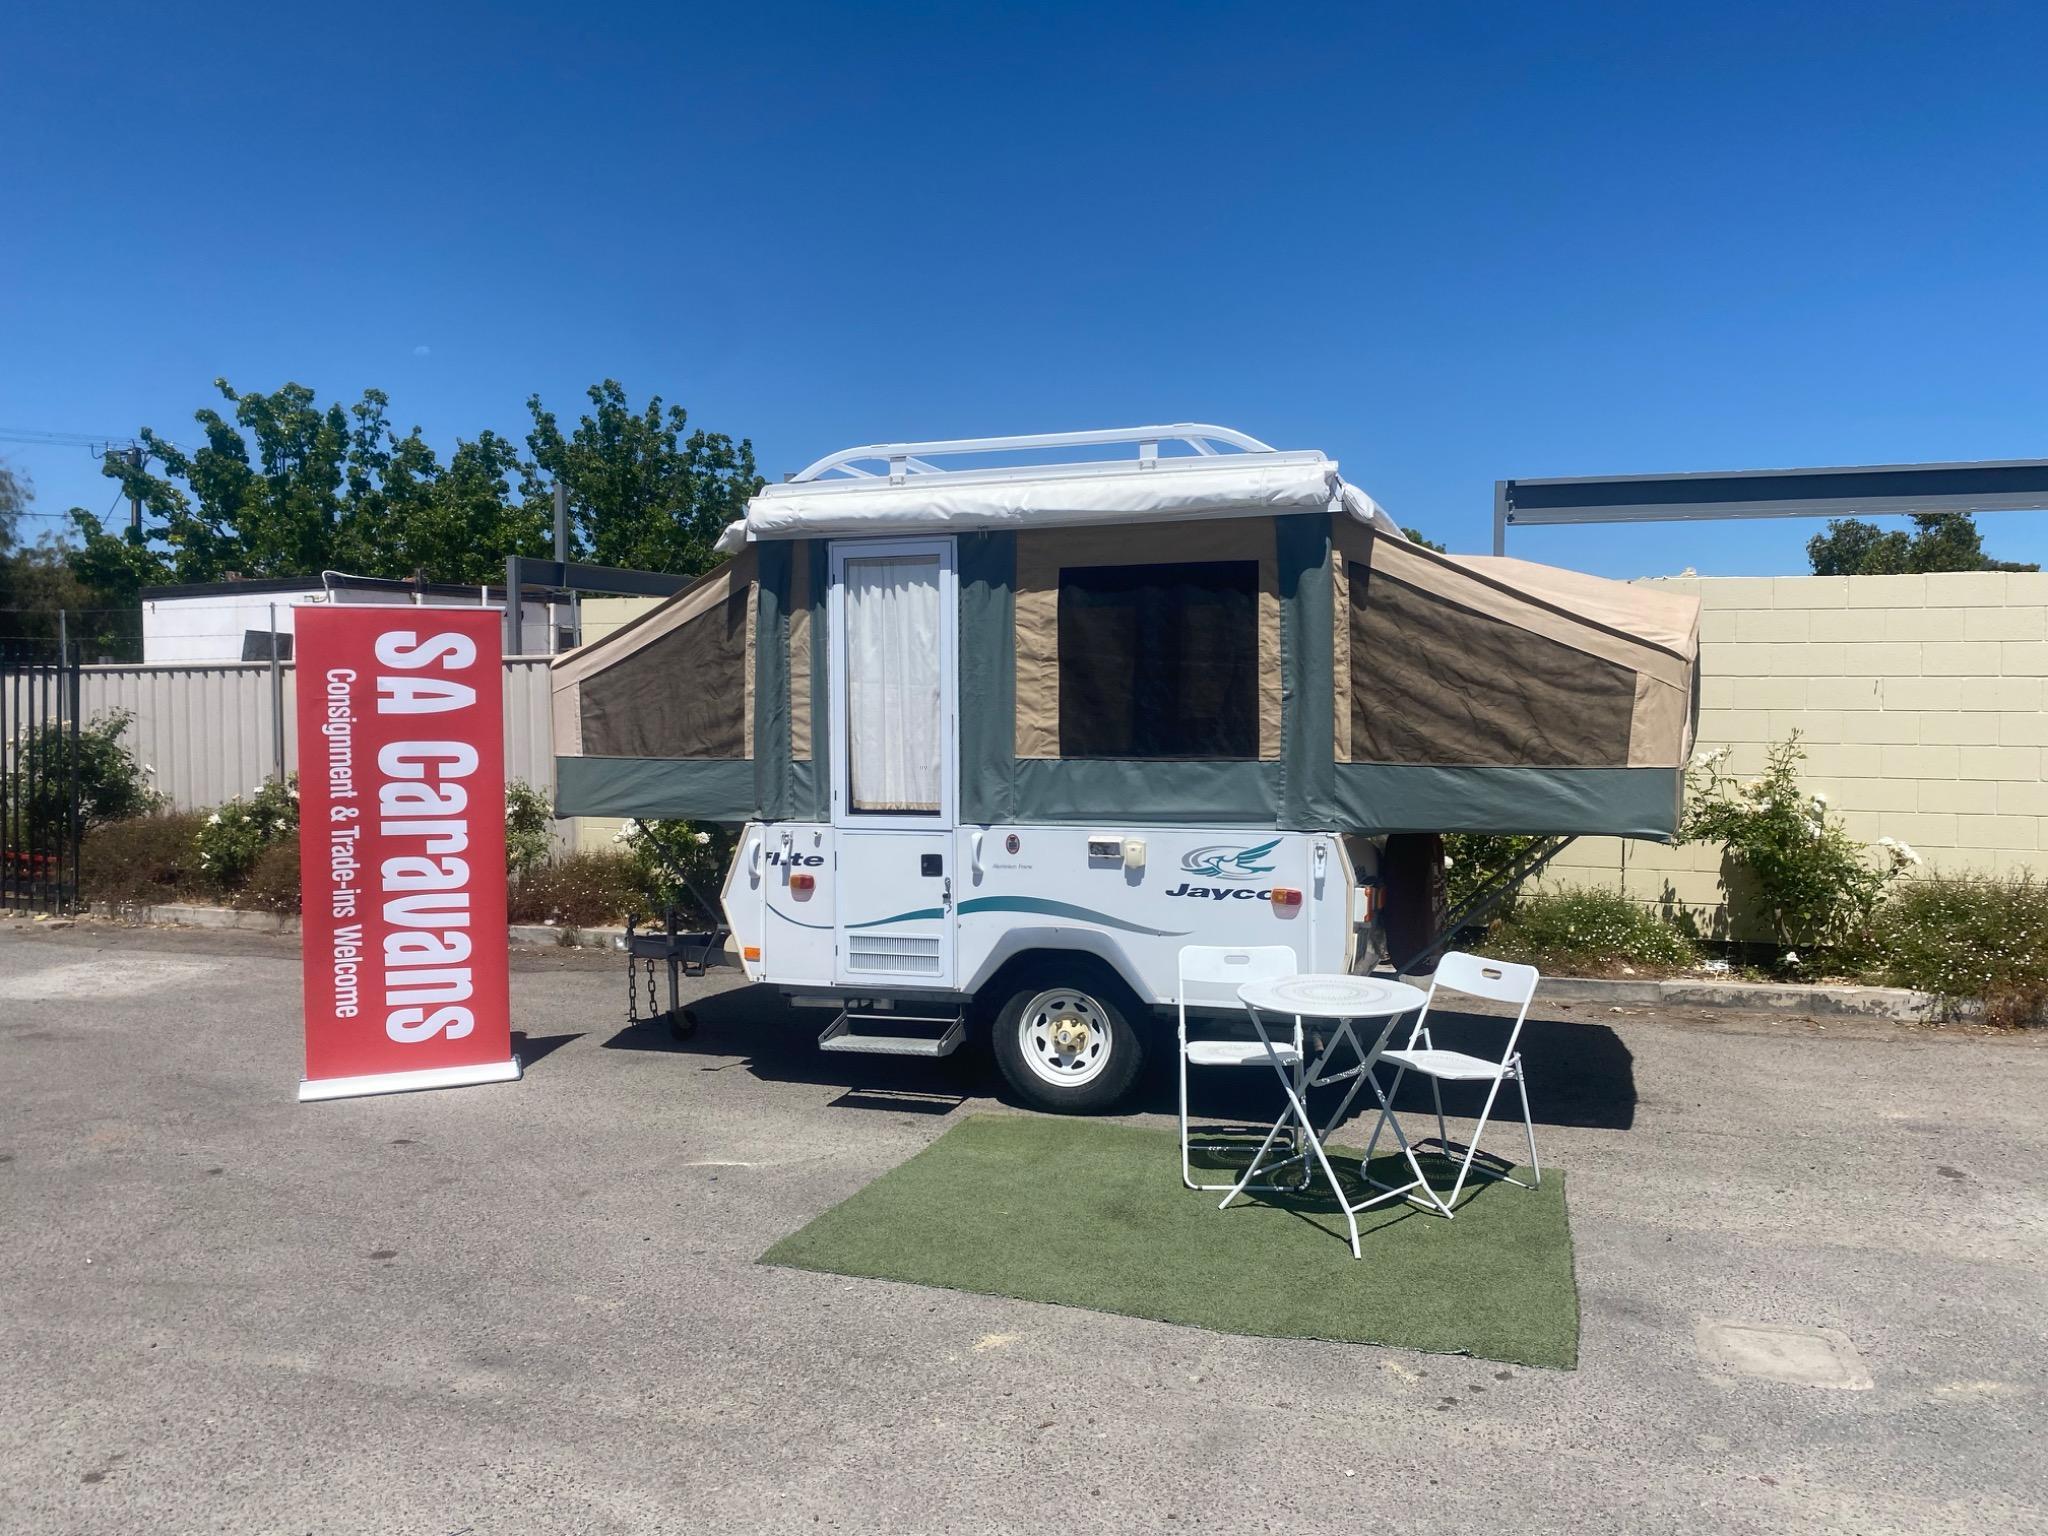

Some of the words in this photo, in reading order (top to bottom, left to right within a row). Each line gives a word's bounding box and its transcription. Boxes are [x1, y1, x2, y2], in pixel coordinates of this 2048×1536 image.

[374, 630, 478, 714] SA
[321, 668, 357, 799] Consignment
[329, 806, 360, 822] &
[330, 825, 363, 918] Trade-ins
[377, 740, 480, 1044] Caravans
[333, 924, 364, 1018] Welcome
